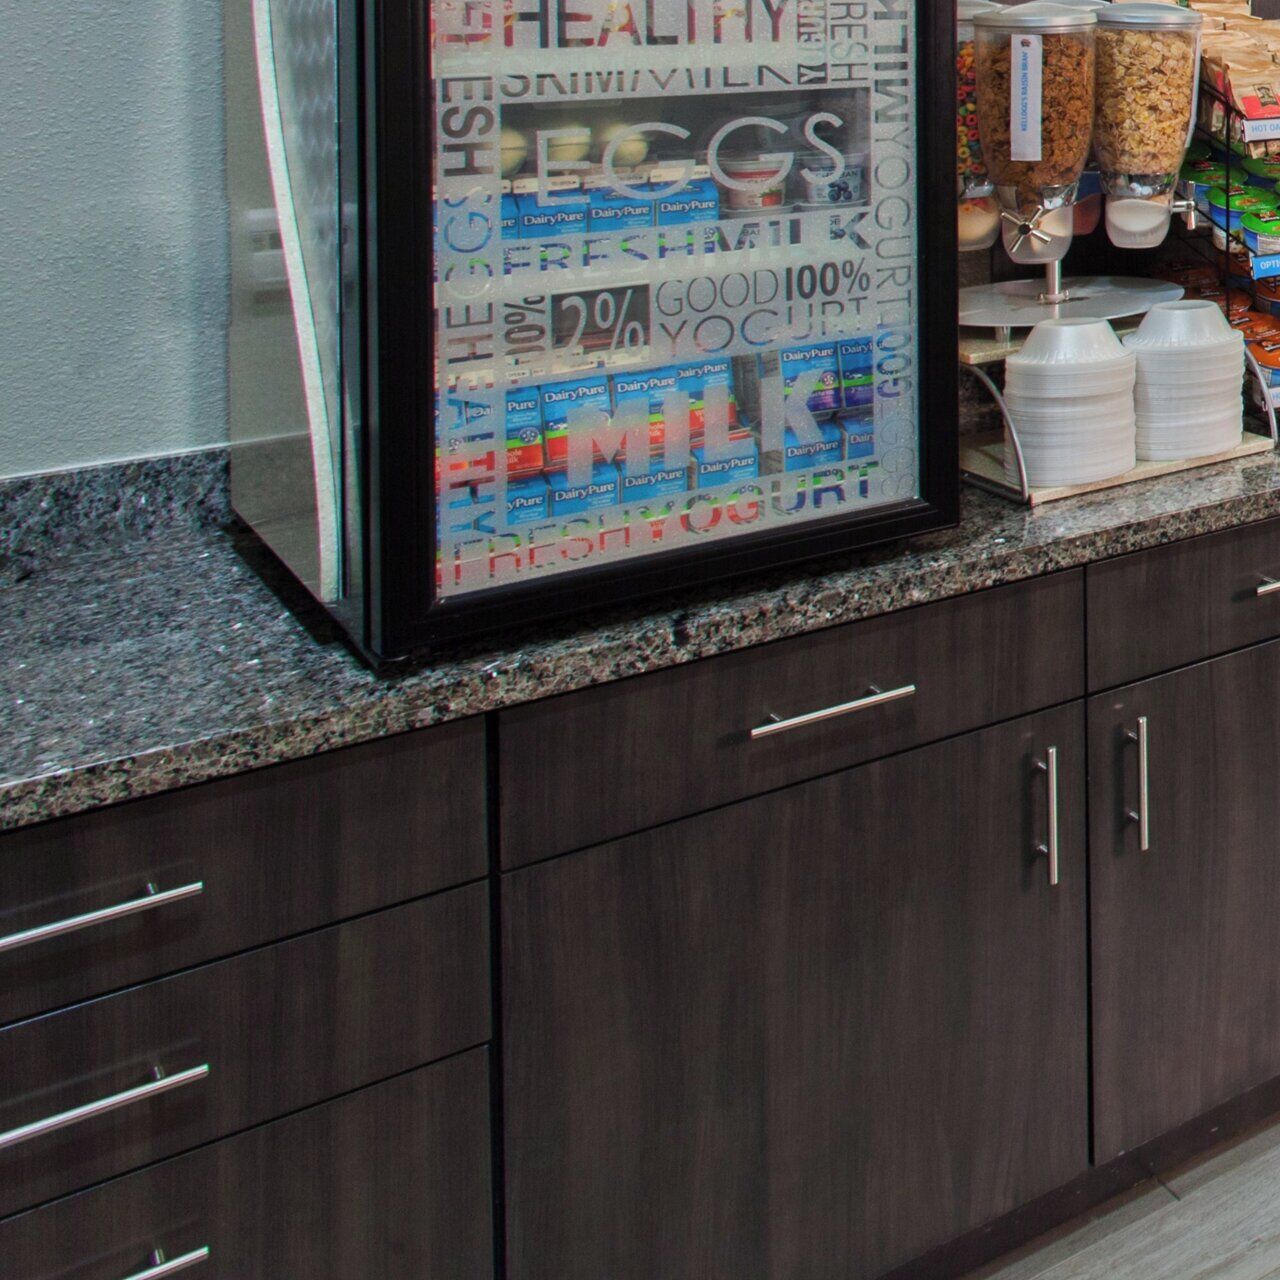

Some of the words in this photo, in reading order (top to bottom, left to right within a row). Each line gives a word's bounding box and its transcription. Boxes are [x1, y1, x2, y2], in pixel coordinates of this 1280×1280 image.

[1020, 51, 1029, 72] BRAN
[440, 2, 495, 176] FESH
[1020, 73, 1029, 96] RAISIN
[1251, 123, 1268, 133] HOT
[536, 112, 847, 207] EGGS
[592, 205, 650, 220] DairyPure
[661, 200, 716, 213] DairyPure
[874, 124, 912, 308] YOGURT
[524, 211, 584, 226] DairyPure
[443, 184, 494, 329] EGGS
[503, 228, 697, 280] FRESH
[655, 269, 778, 317] GOOD
[785, 257, 871, 301] 100%
[561, 289, 647, 360] 2%
[783, 348, 834, 362] DairyPure
[544, 383, 606, 404] DairyPure
[617, 376, 676, 394] DairyPure
[447, 333, 495, 534] HEALTHY
[567, 370, 826, 492] MILK
[787, 440, 839, 458] DairyPure
[700, 455, 755, 474] DairyPure
[624, 469, 684, 488] DairyPure
[554, 481, 615, 502] DairyPure
[454, 510, 632, 586] FRESH
[637, 461, 880, 546] YOGURT
